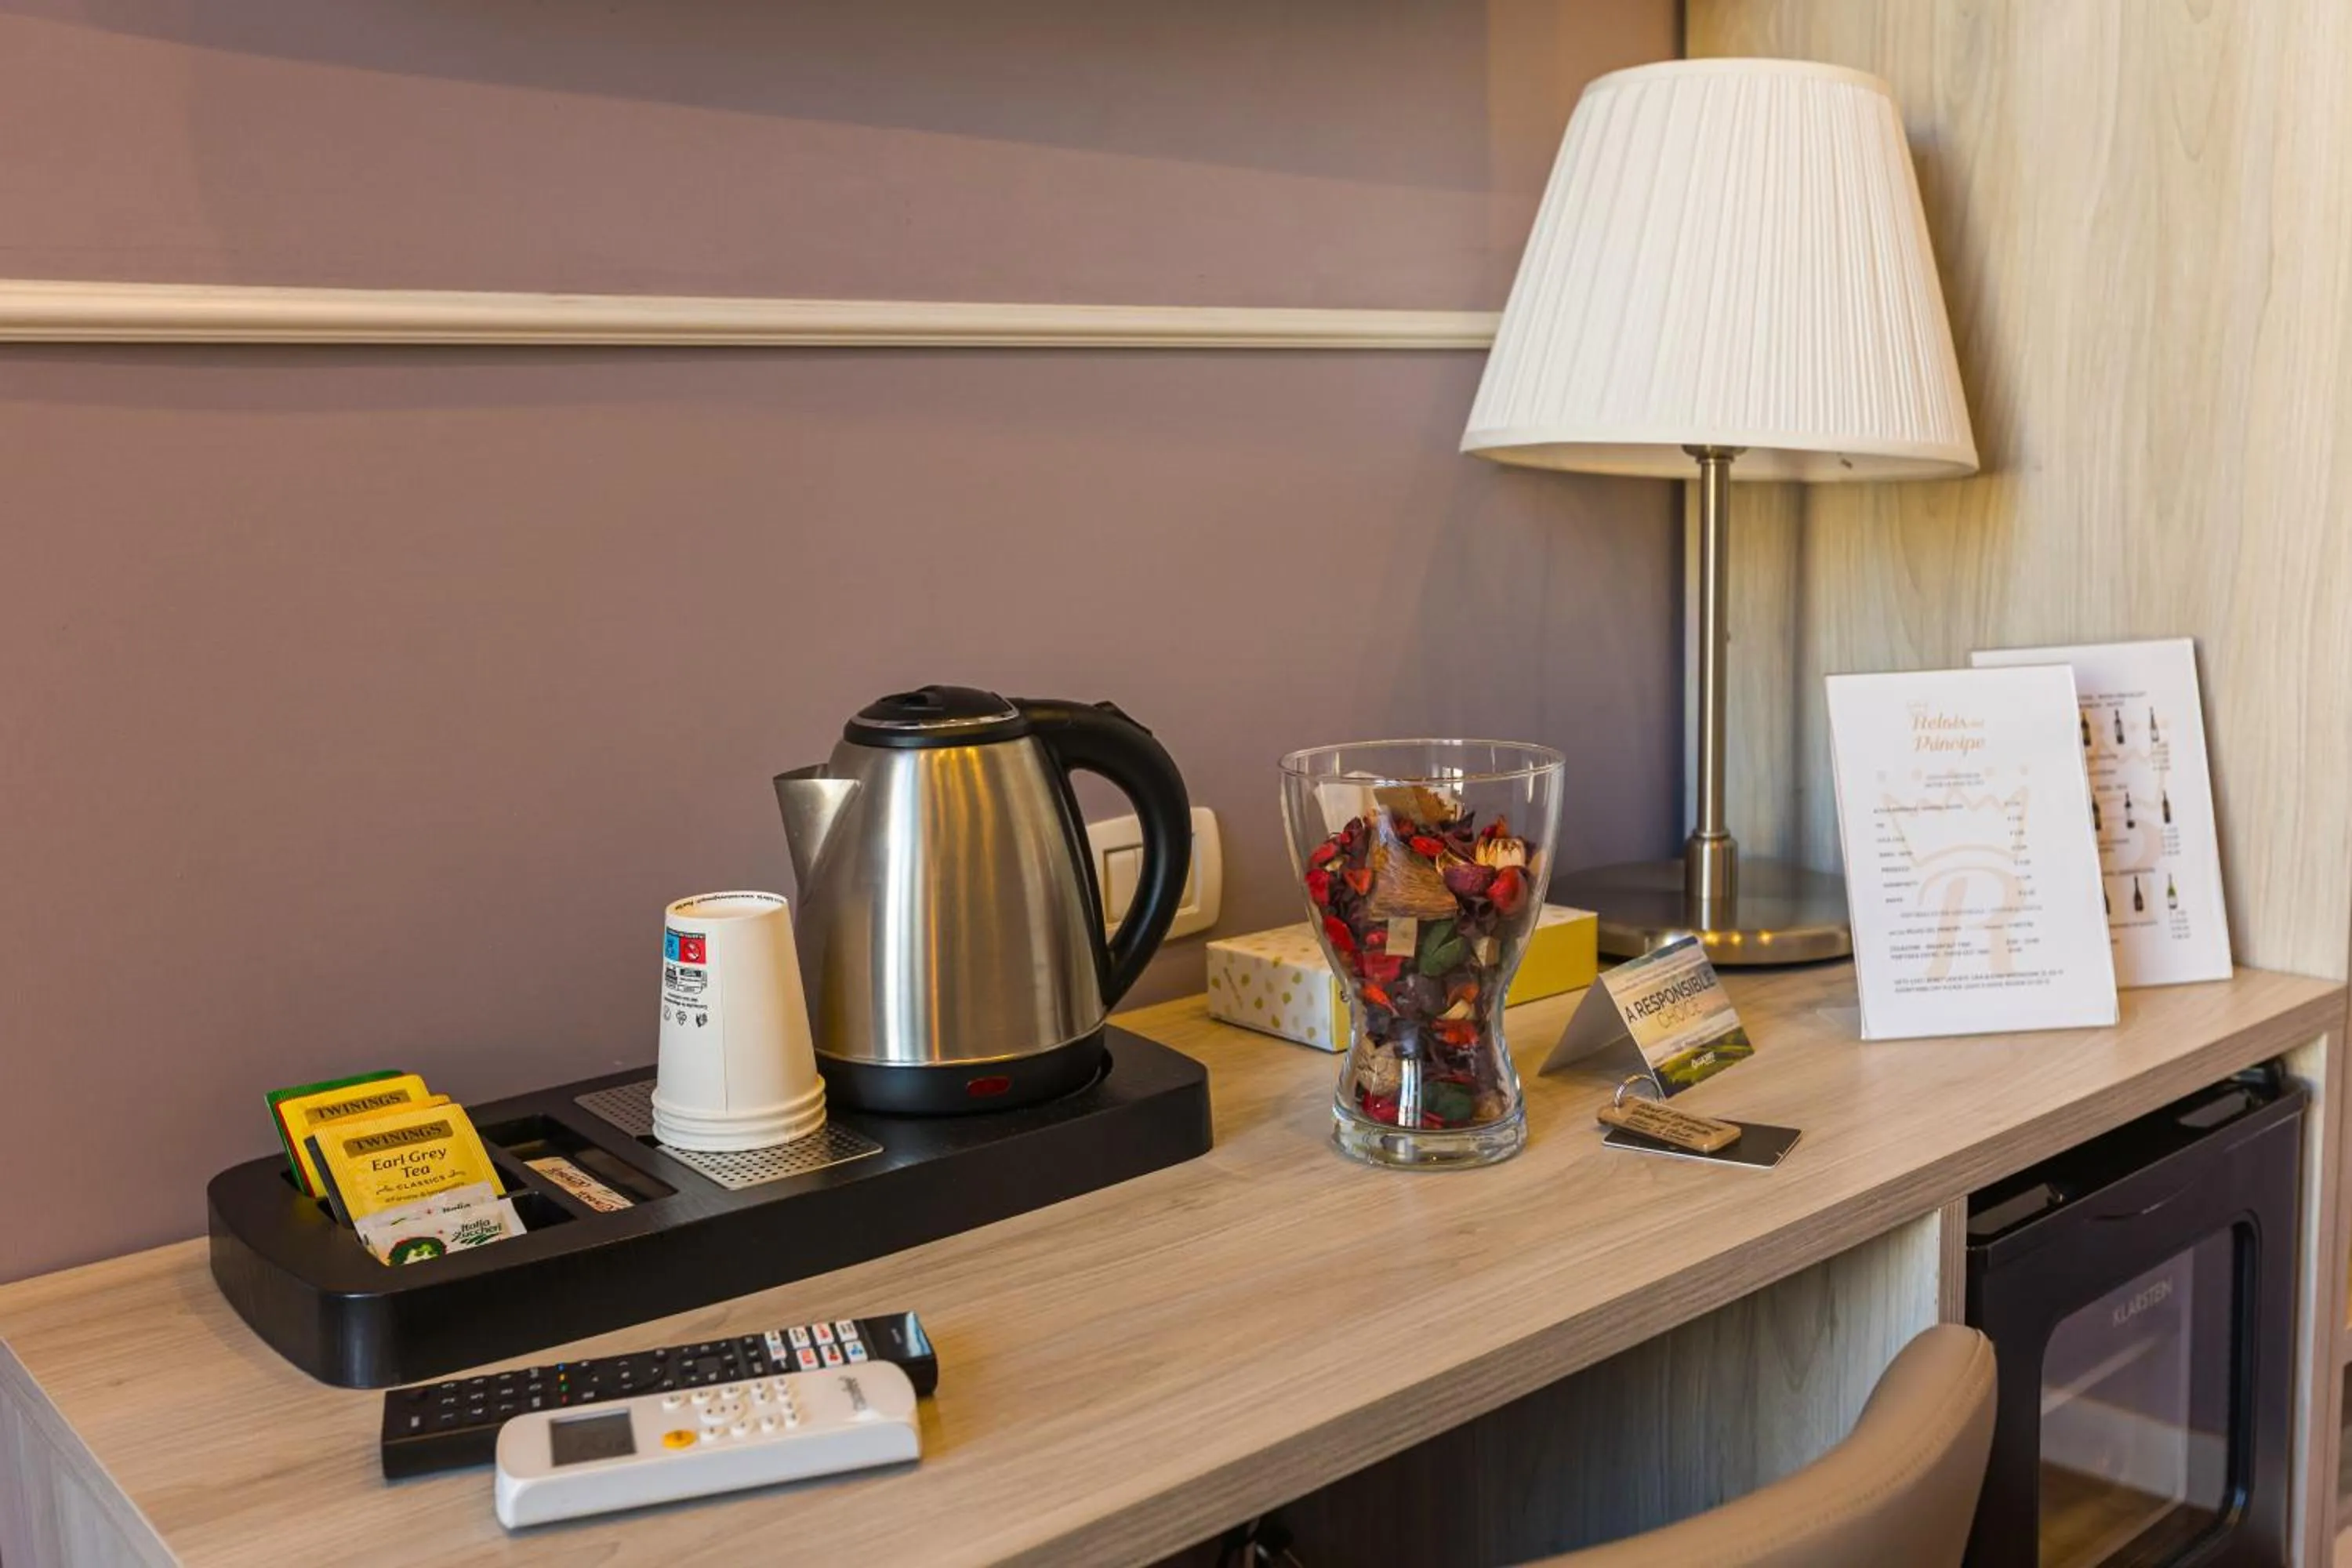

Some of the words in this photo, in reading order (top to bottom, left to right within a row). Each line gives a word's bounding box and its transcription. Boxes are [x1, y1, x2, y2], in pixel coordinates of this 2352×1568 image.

[1624, 1006, 1637, 1022] A
[1635, 970, 1716, 1017] RESPONSIBLE
[1656, 997, 1702, 1029] CHOICE
[315, 1093, 401, 1120] TWININGS
[353, 1123, 443, 1151] TWININGS
[372, 1153, 405, 1172] Earl
[408, 1147, 447, 1163] Grey
[401, 1165, 431, 1179] Tea
[396, 1175, 446, 1192] CLASSICS
[461, 1218, 491, 1232] Italia
